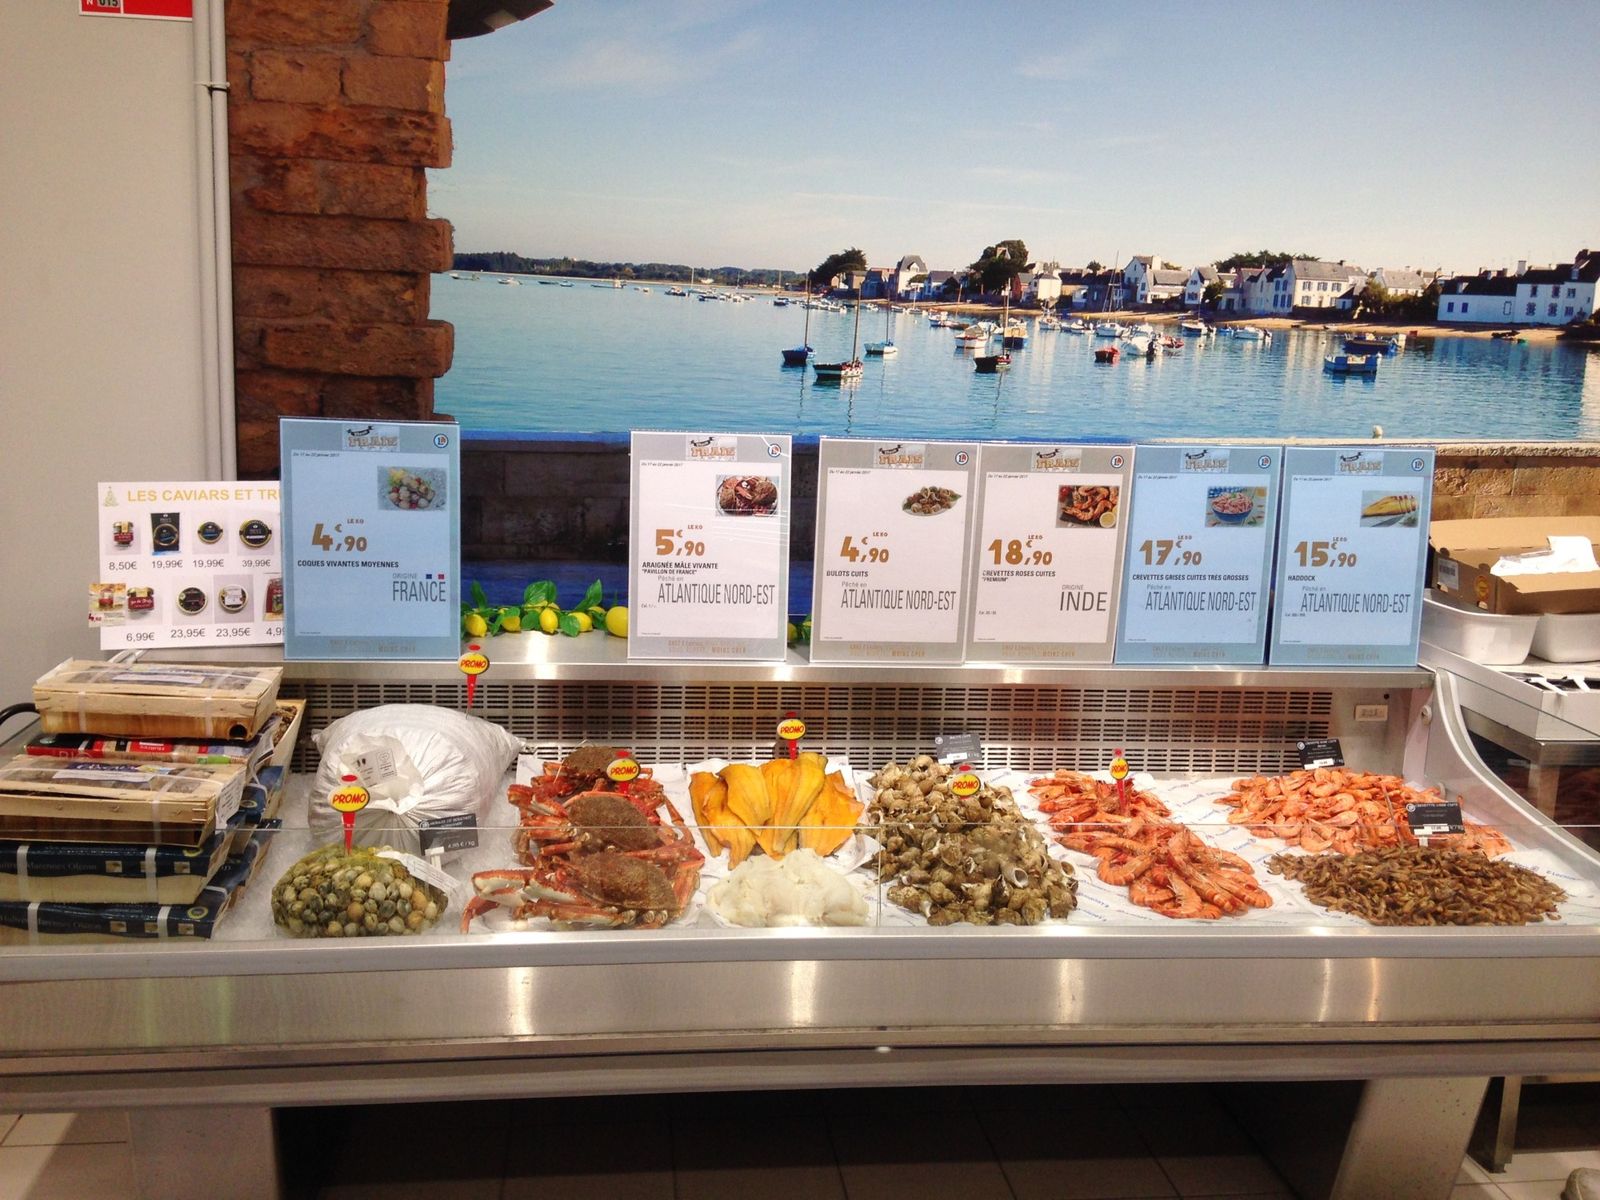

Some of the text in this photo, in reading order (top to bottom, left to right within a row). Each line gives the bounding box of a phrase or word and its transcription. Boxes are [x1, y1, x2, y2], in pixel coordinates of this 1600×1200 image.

[128, 490, 157, 501] LES
[162, 489, 229, 501] CAVIARS
[235, 489, 252, 500] ET
[109, 561, 137, 571] 8,50€
[152, 560, 183, 569] 19,99€
[193, 559, 224, 568] 19,99€
[242, 559, 271, 568] 39,99€
[392, 581, 446, 602] FRANCE
[658, 583, 775, 604] ATLANTIQUE NORD-EST
[841, 589, 956, 610] ATLANTIQUE NORD-EST
[1060, 592, 1108, 612] INDE
[1145, 591, 1256, 611] ATLANTIQUE NORD-EST
[1301, 593, 1410, 613] ATLANTIQUE NORD-EST
[127, 632, 154, 642] 6,99€
[171, 628, 206, 638] 23,95€
[216, 628, 250, 638] 23,95€
[460, 660, 486, 668] PROMO
[780, 726, 804, 734] PROMO
[611, 766, 637, 775] PROMO
[952, 781, 977, 789] PROMO
[332, 794, 366, 803] PROMO
